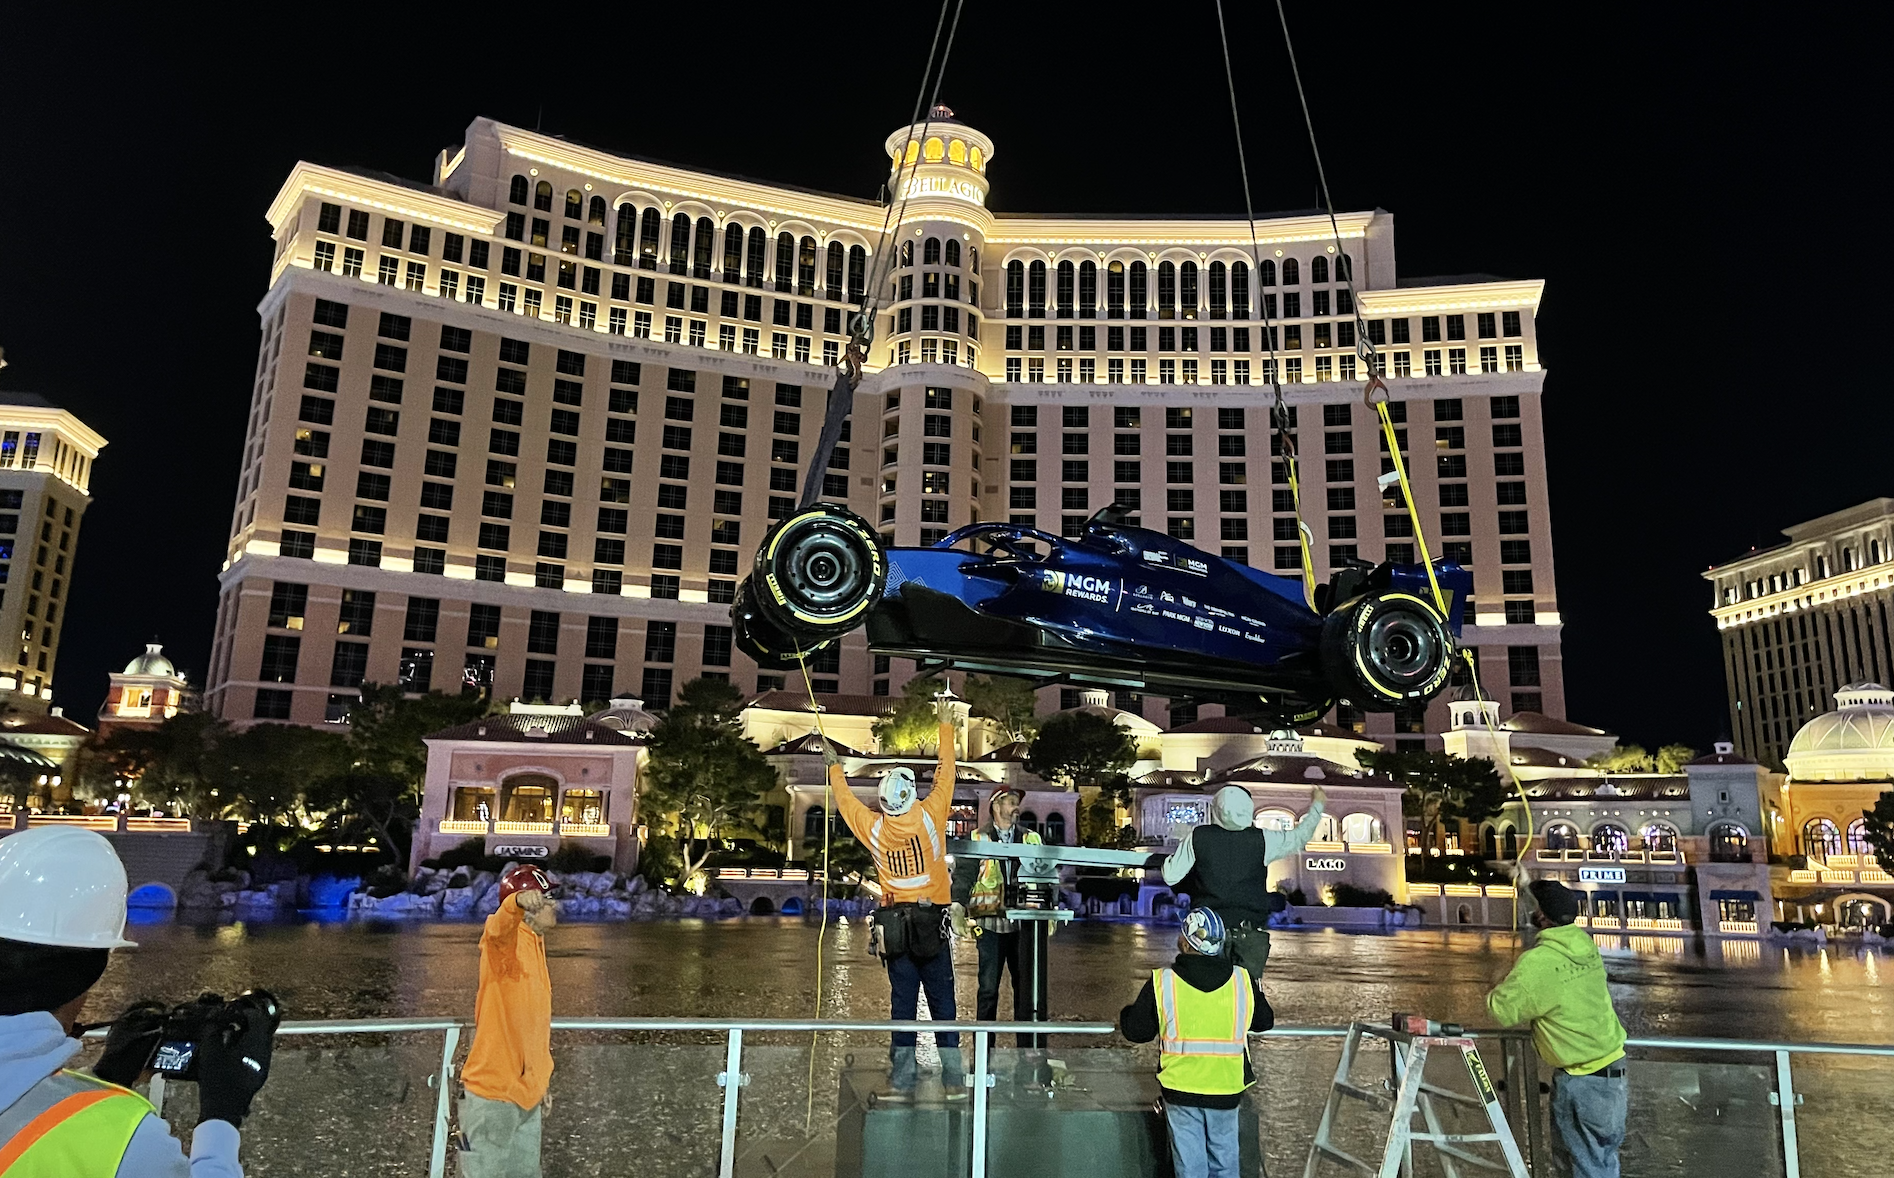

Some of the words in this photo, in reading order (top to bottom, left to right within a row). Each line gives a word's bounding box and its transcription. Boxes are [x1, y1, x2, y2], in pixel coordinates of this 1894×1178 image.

[900, 177, 984, 204] BELLAGIO
[858, 529, 881, 577] ZERO
[1188, 558, 1208, 569] MGM
[1068, 573, 1110, 595] MGM
[1176, 613, 1191, 622] MGM
[1218, 625, 1241, 637] LUXOR
[1423, 655, 1452, 696] ZERO
[497, 846, 544, 857] JASMINE
[1307, 859, 1345, 871] LAGO
[1581, 870, 1623, 880] PRIME
